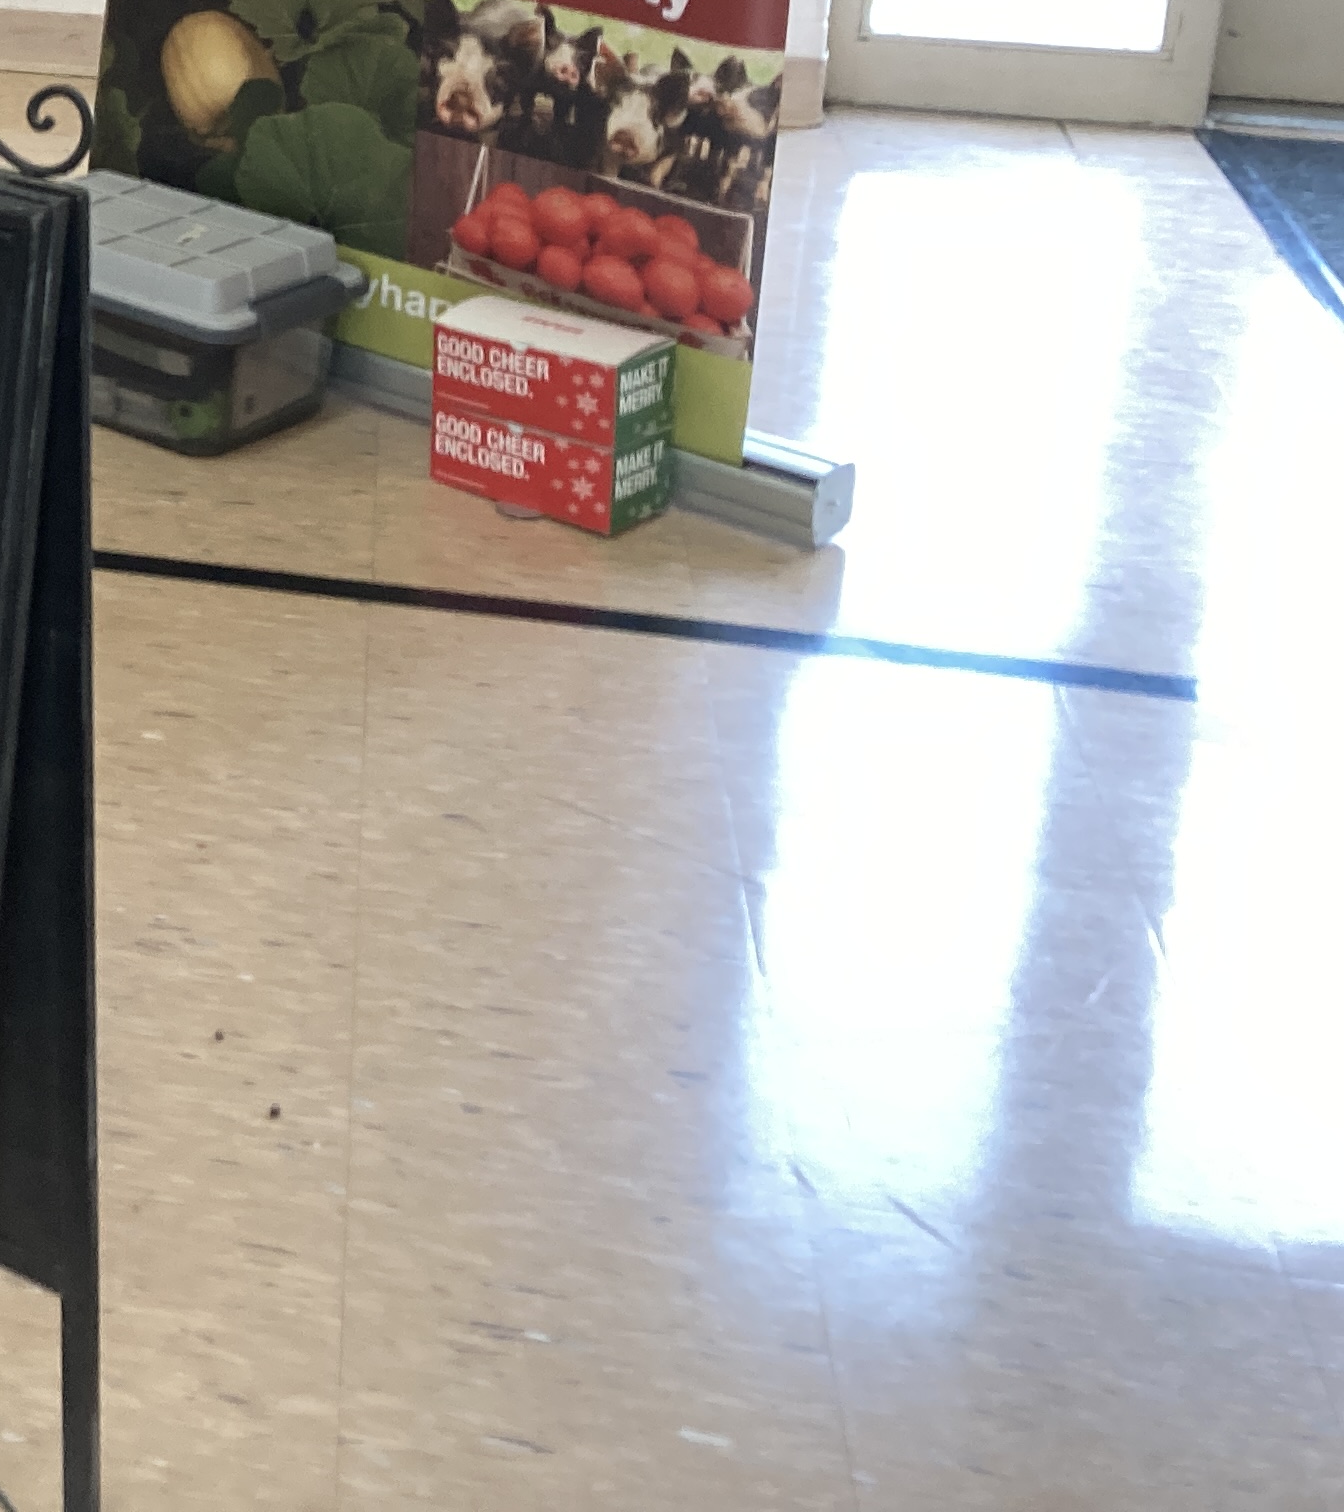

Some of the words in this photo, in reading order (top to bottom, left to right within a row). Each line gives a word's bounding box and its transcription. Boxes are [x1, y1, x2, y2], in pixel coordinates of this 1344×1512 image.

[437, 332, 485, 365] GOOD
[489, 347, 550, 382] CHEER
[437, 355, 534, 399] ENCLOSED.
[620, 364, 656, 393] MAKE
[657, 356, 670, 379] IT
[435, 411, 482, 443] GOOD
[486, 427, 546, 465] CHEER
[435, 434, 531, 480] ENCLOSED.
[615, 447, 650, 476] MAKE
[651, 440, 665, 461] IT
